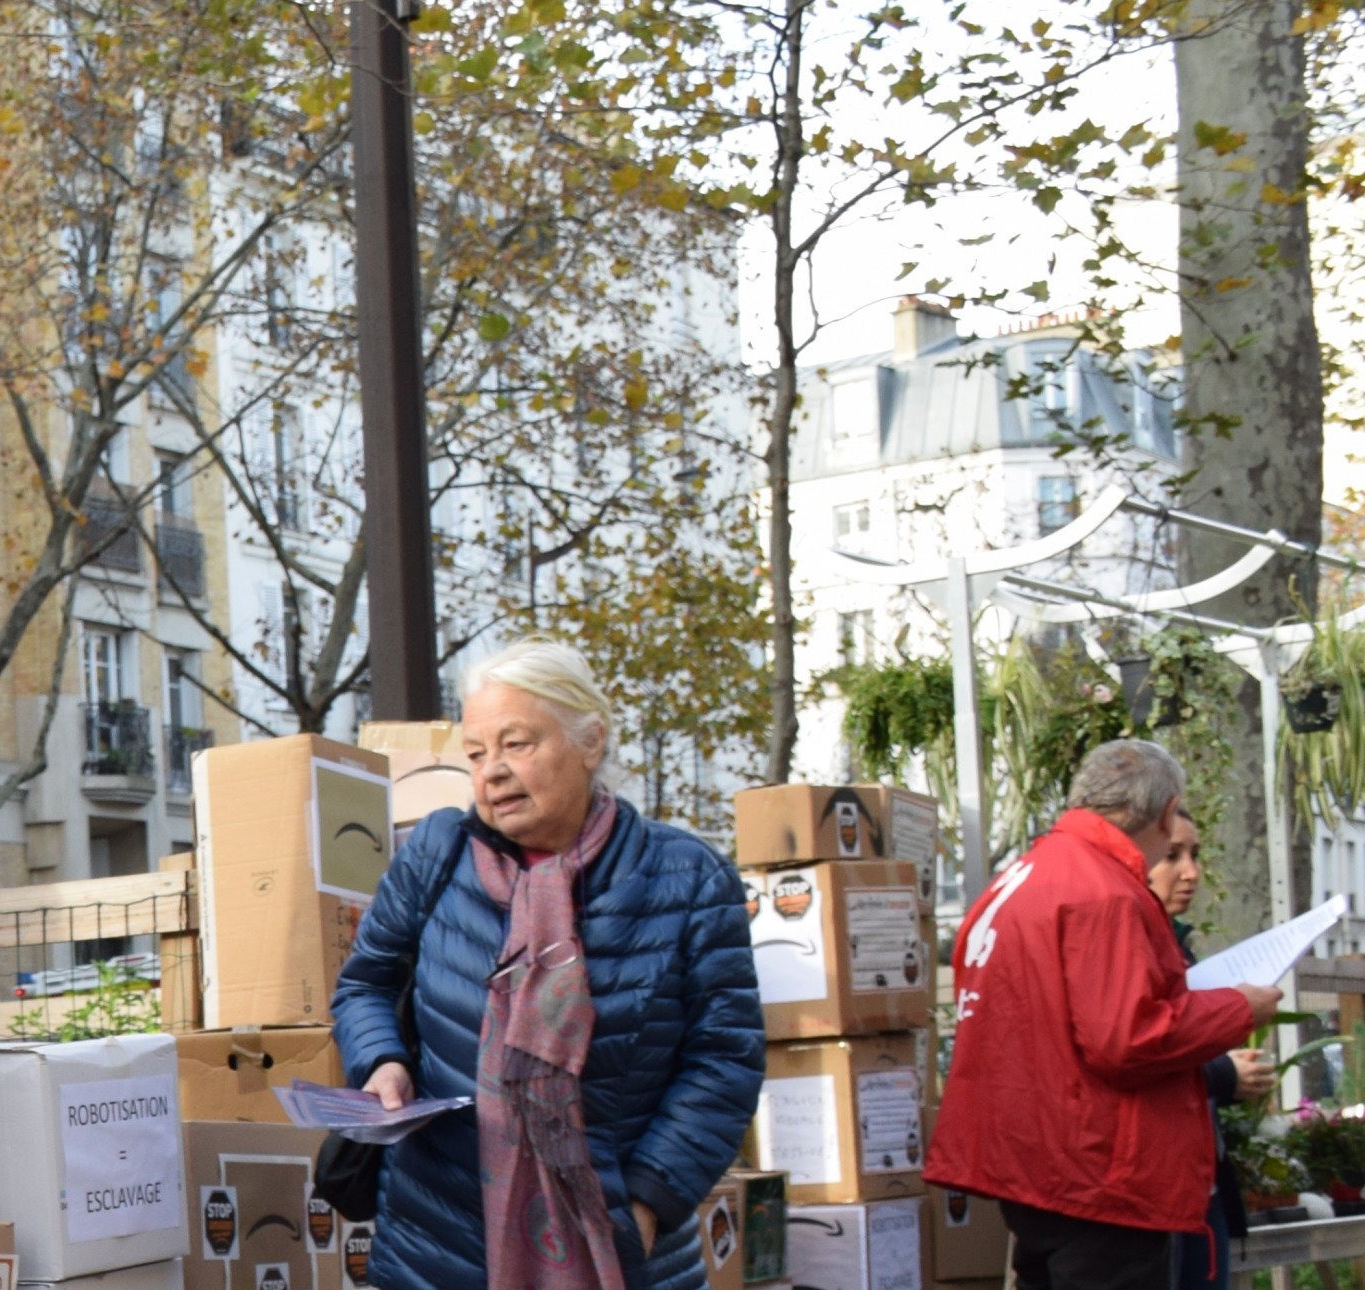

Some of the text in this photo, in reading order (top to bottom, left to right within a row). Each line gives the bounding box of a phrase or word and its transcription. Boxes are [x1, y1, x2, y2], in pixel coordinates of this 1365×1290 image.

[68, 1096, 168, 1127] ROBOTISATION
[119, 1151, 127, 1160] =
[86, 1182, 161, 1214] ESCLAVAGE
[208, 1203, 232, 1218] STOP
